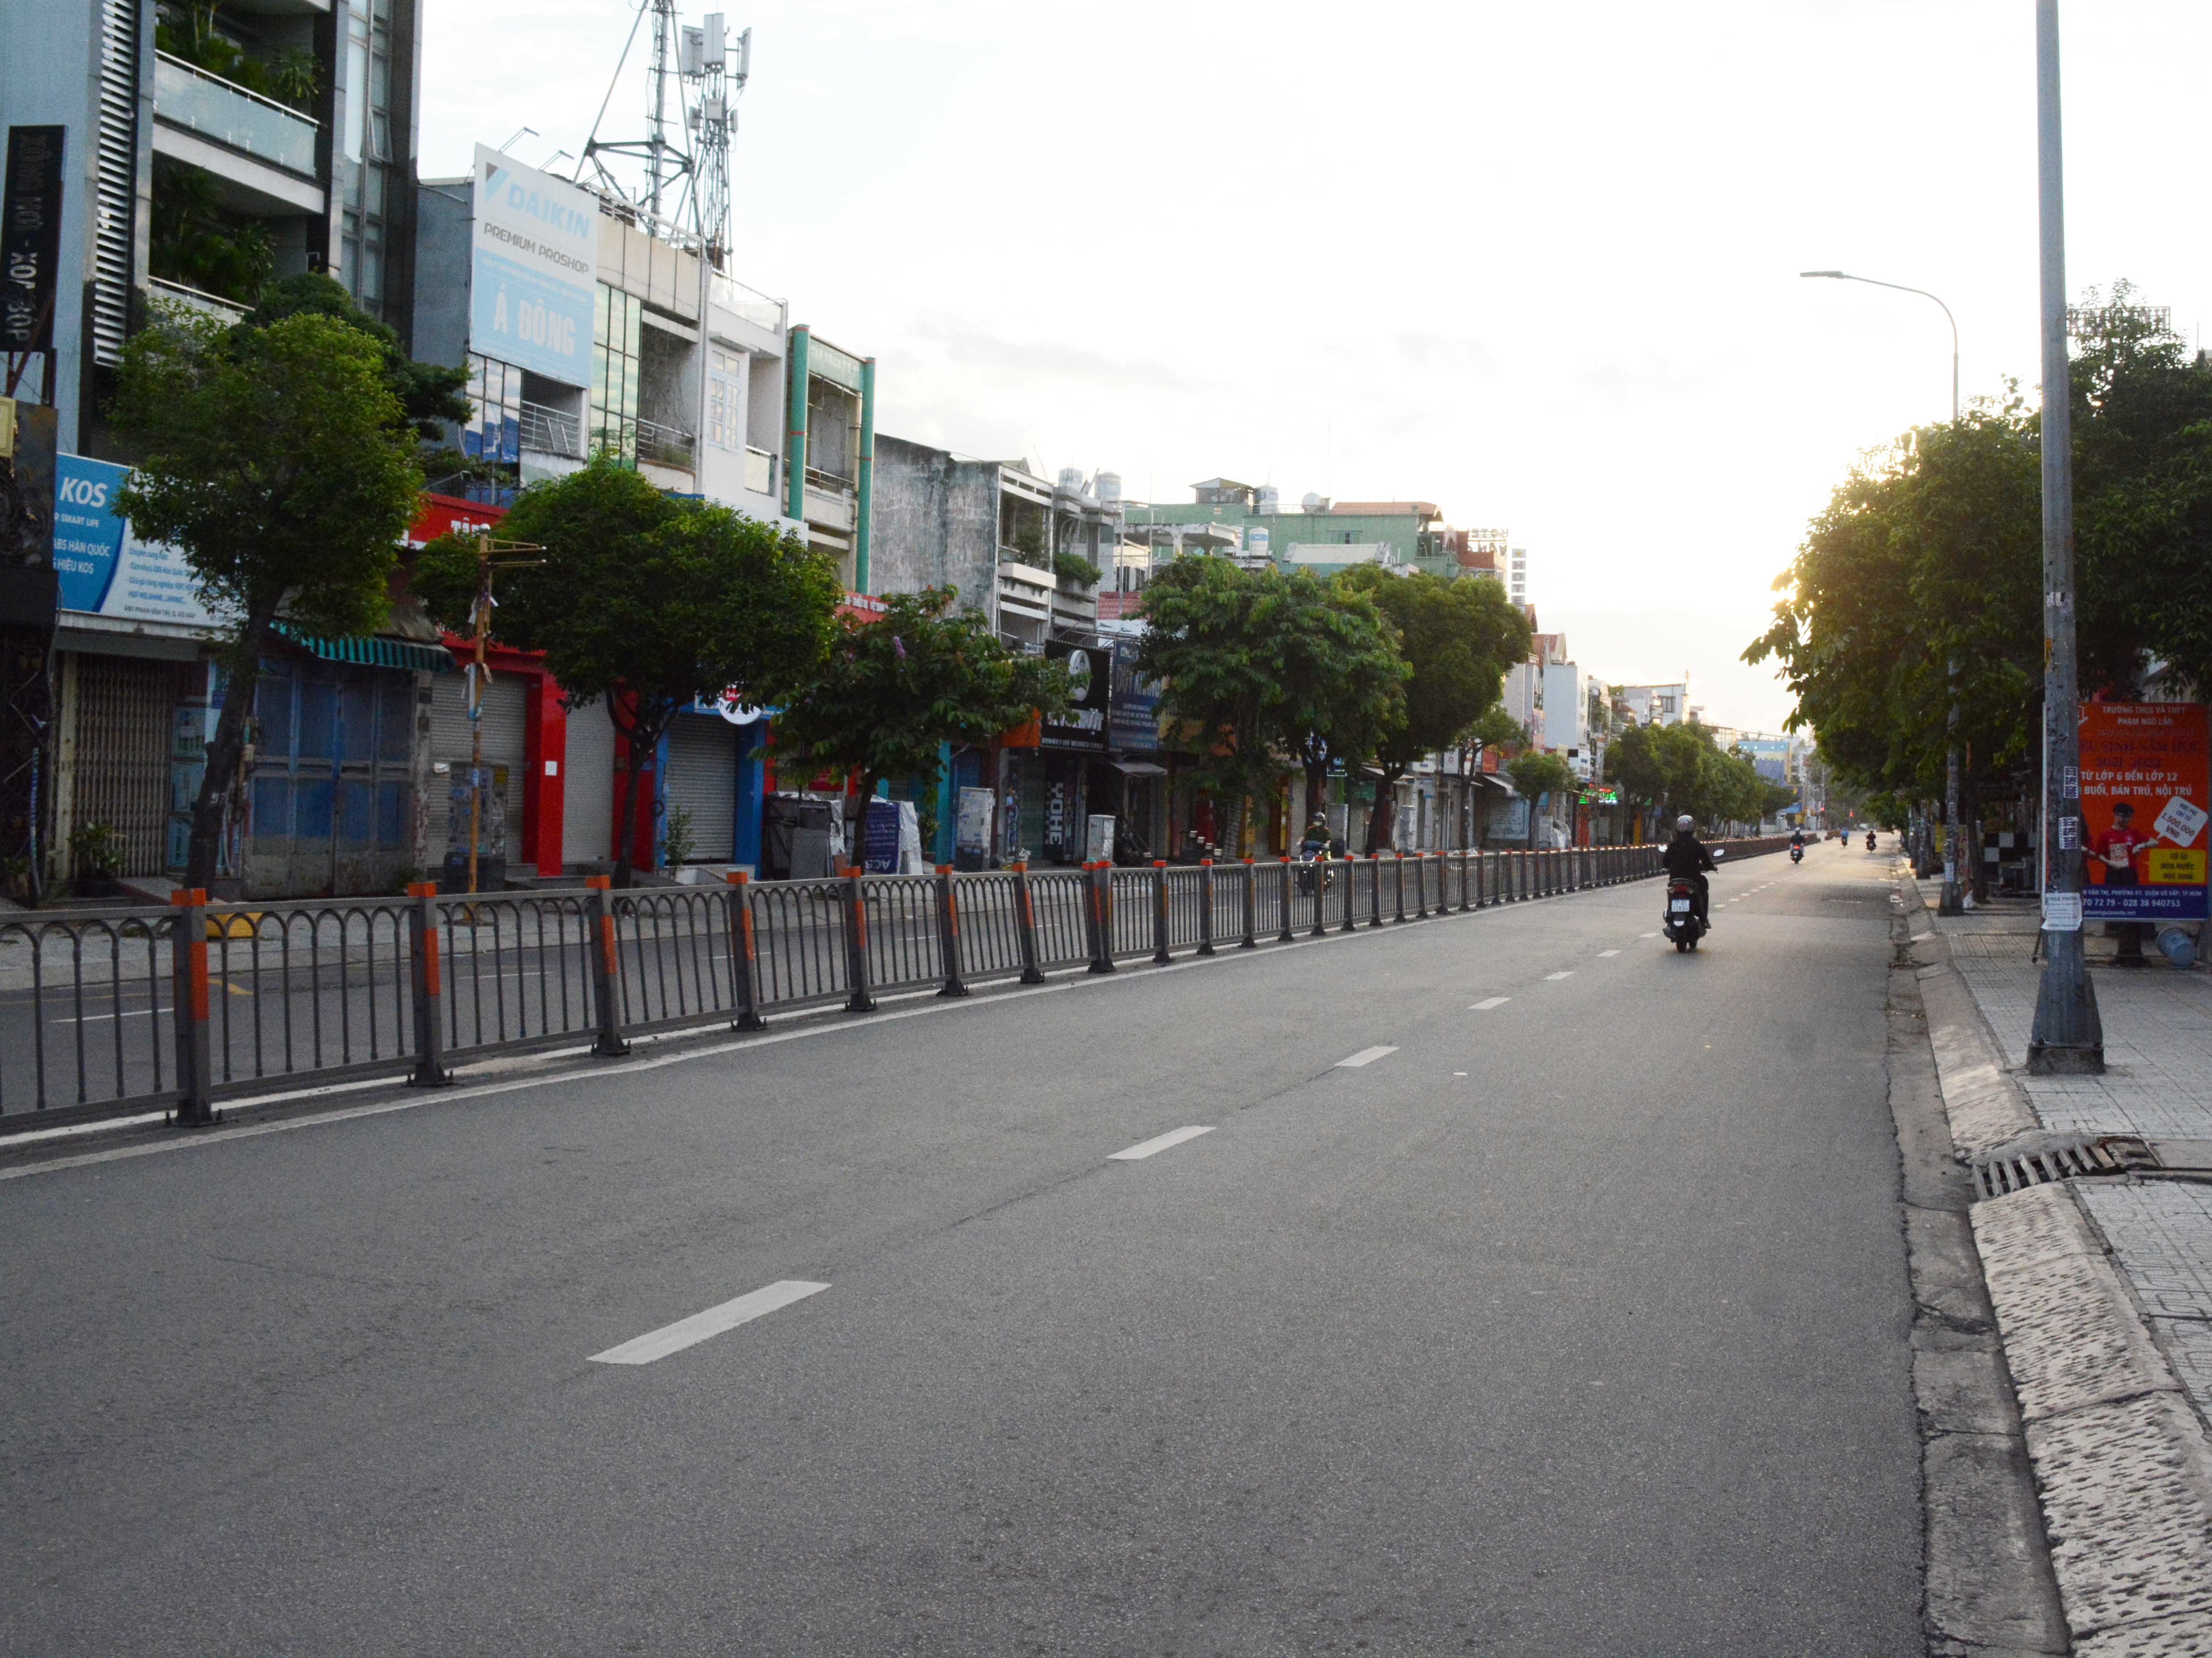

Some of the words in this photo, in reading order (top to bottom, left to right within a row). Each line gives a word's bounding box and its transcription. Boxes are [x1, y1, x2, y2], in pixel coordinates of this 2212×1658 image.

[507, 182, 590, 239] DAIKIN
[484, 222, 536, 253] PREMIUM
[538, 245, 589, 274] PROSHOP
[493, 282, 508, 334] Á
[518, 297, 576, 357] ĐÔNG
[59, 477, 108, 507] KOS
[60, 514, 85, 525] SMART
[86, 518, 99, 528] LIFE
[68, 539, 86, 553] HÀN
[88, 542, 111, 557] QUỐC
[78, 562, 94, 574] KOS
[1513, 561, 1523, 605] HOTE
[2081, 769, 2094, 780] TỪ
[2096, 769, 2114, 780] LỚP
[2117, 772, 2121, 780] 6
[2124, 769, 2143, 780] ĐẾN
[2146, 770, 2164, 780] LỚP
[2167, 772, 2177, 781] 12
[2084, 783, 2108, 796] BUỔI,
[2111, 784, 2130, 795] BÁN
[2132, 784, 2153, 796] TRÚ,
[2156, 784, 2171, 797] NỘI
[2174, 784, 2192, 795] TRÚ
[2162, 812, 2195, 837] 1.500.000
